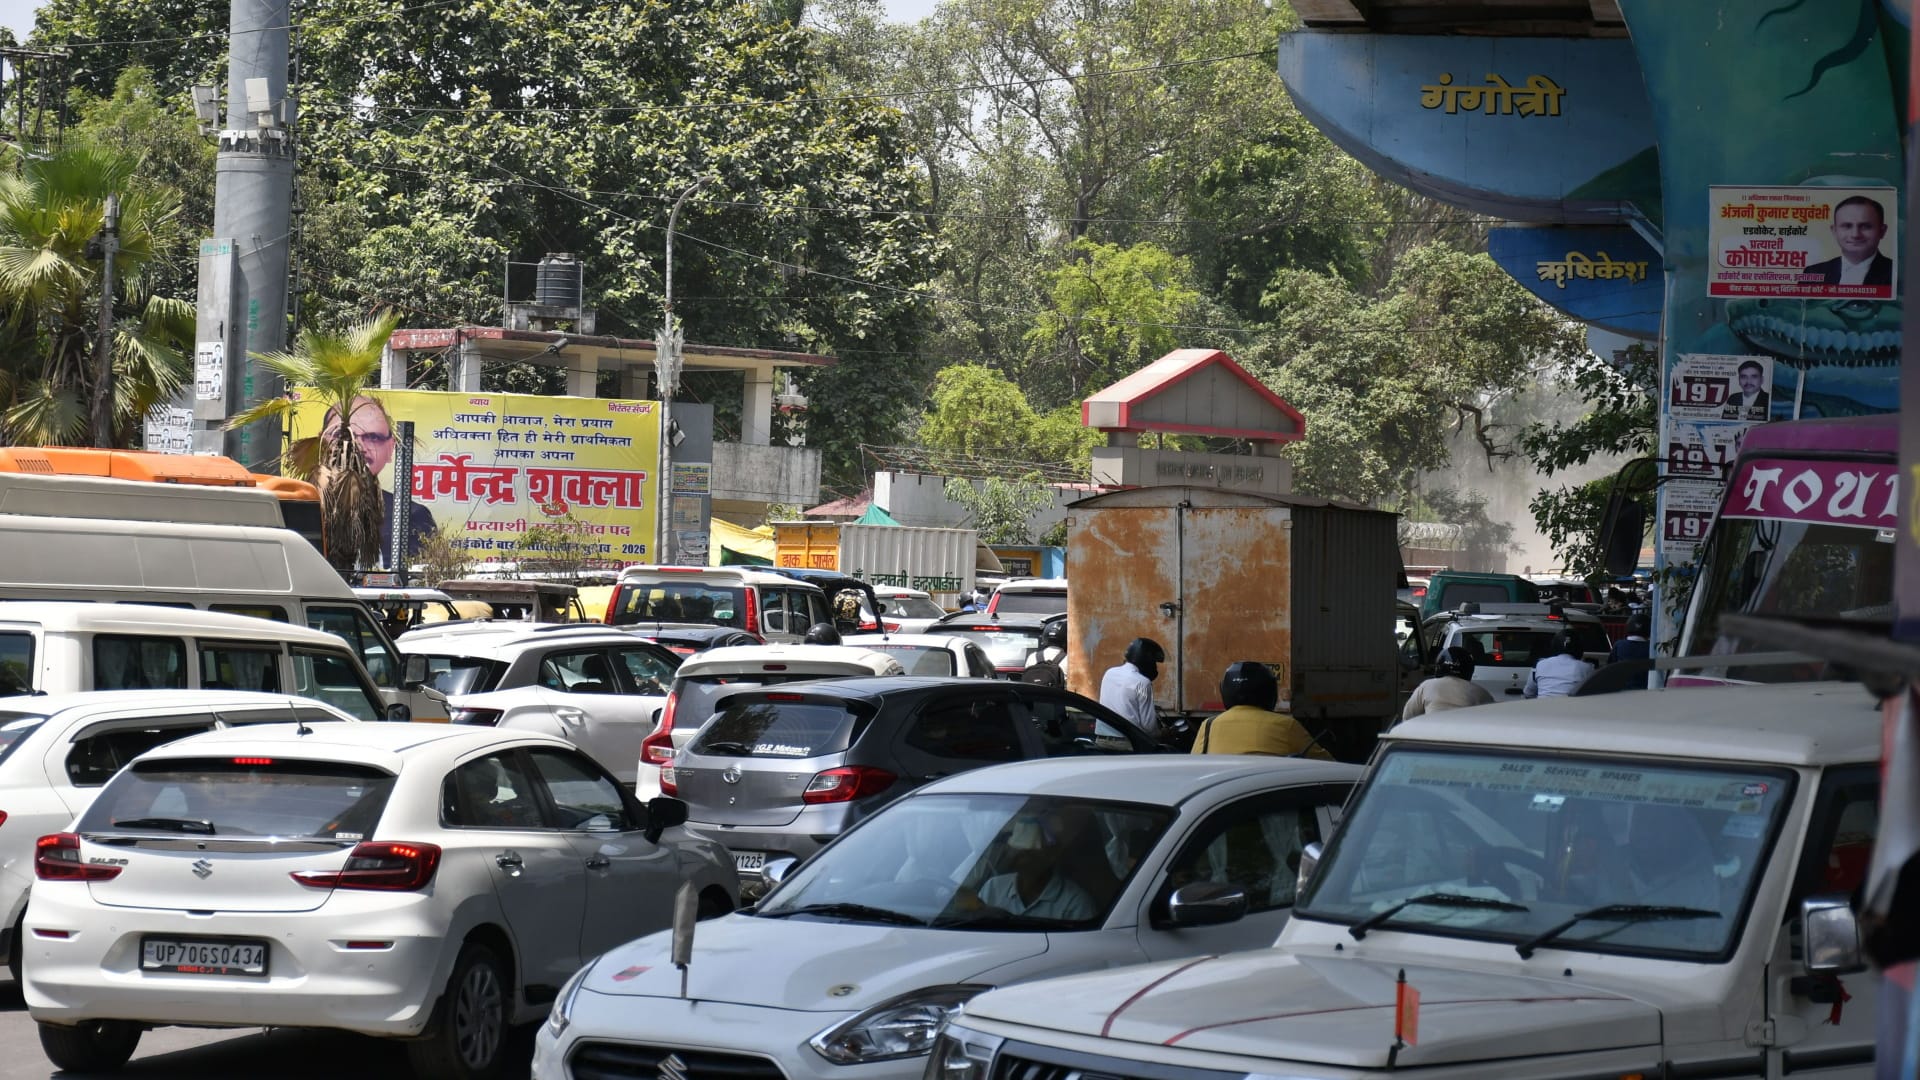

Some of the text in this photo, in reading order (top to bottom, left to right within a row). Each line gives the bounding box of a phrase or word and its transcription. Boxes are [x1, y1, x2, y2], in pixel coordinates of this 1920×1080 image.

[1421, 73, 1566, 118] गंगोत्री
[1721, 204, 1830, 222] अंजनी कुमार रघुवंशी
[1779, 225, 1808, 236] हाईकोर्ट
[1749, 238, 1784, 250] प्रत्याशी
[1725, 245, 1808, 267] कोषाध्यक्ष
[1536, 252, 1648, 289] ऋषिकेश
[1680, 382, 1726, 402] 197
[469, 398, 489, 406] न्याय
[454, 412, 613, 429] आपकी आवाज, मेरा प्रयास
[433, 427, 632, 447] अधिवक्ता हित ही मेरी प्राथमिकता
[495, 450, 575, 461] आपका अपना
[526, 468, 646, 516] शुक्ला
[466, 519, 527, 533] प्रत्याशी
[609, 525, 631, 537] पद
[622, 544, 646, 555] 2026
[782, 554, 801, 568] डाक
[1500, 762, 1643, 782] SALES SERVICE SPARES
[155, 944, 263, 967] UP70GS0434
